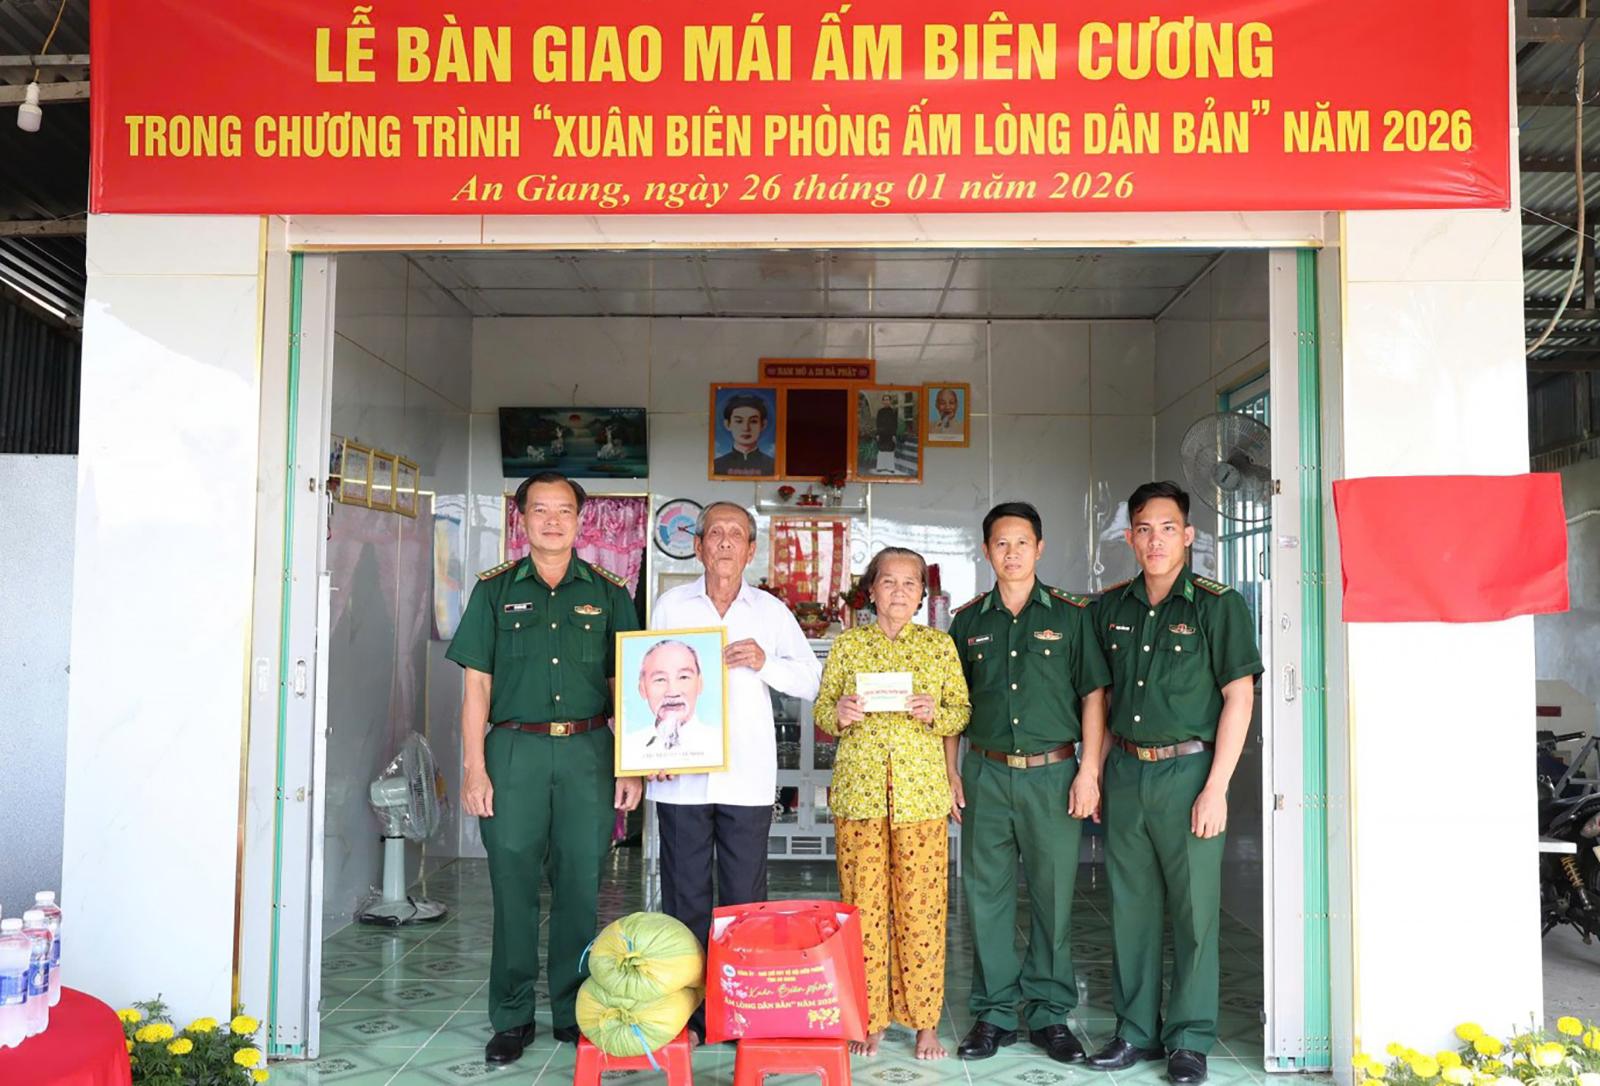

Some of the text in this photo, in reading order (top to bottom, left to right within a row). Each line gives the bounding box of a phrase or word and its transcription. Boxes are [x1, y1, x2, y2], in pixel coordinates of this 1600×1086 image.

[315, 4, 1274, 83] LỄ BÀN GIAO MÁI ẤM BIÊN CƯƠNG
[124, 97, 1473, 158] TRONG CHƯƠNG TRÌNH “XUÂN BIÊN PHÒNG ẤM LÒNG DÂN BẢN” NĂM 2026
[451, 171, 1135, 209] An Giang, ngày 26 tháng 01 năm 2026
[808, 367, 815, 376] A
